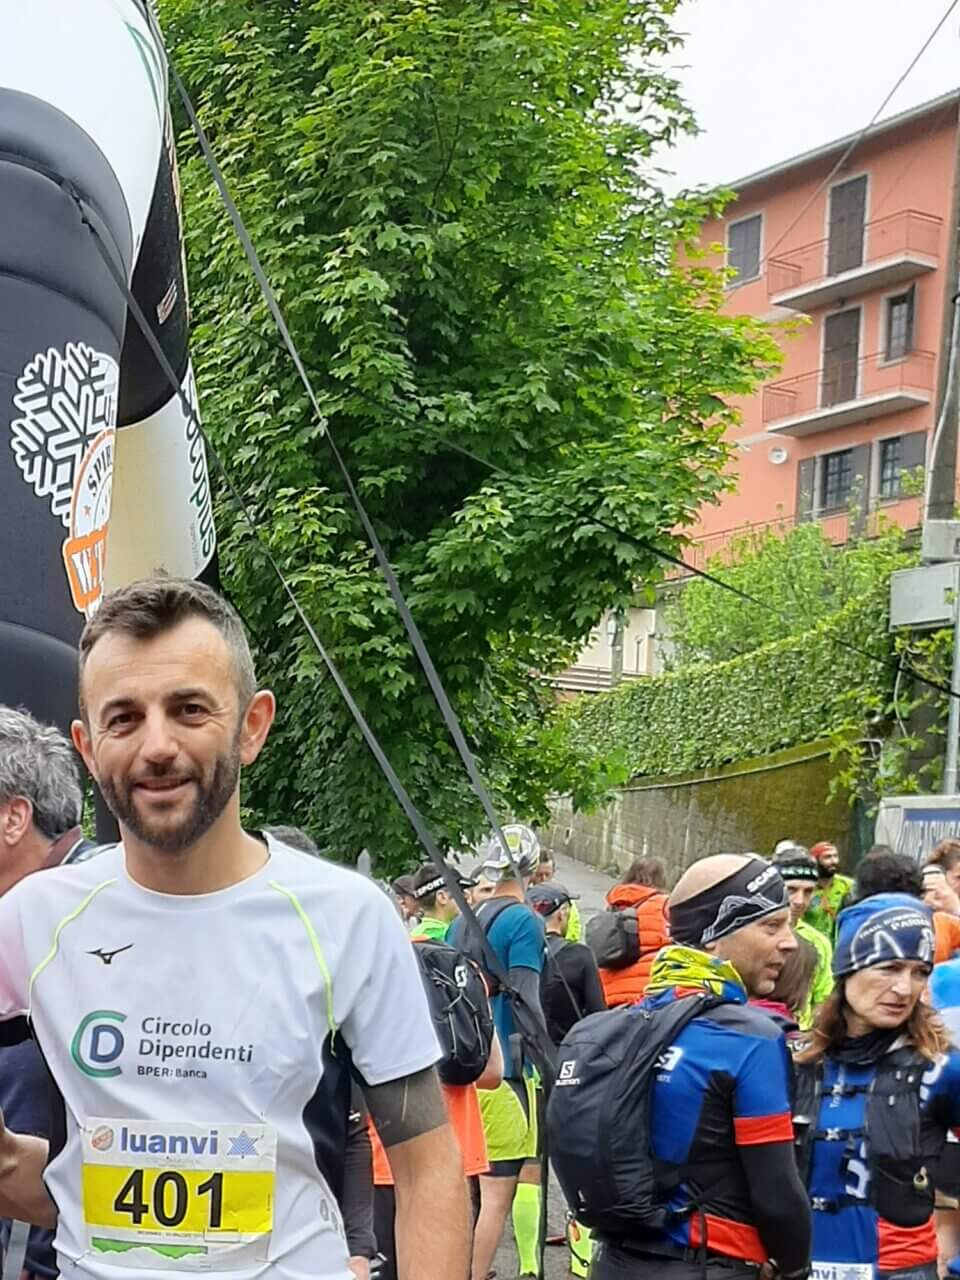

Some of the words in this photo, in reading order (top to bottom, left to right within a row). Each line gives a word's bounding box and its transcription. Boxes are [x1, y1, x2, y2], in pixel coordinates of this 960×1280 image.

[141, 1016, 212, 1036] Circolo
[138, 1039, 254, 1063] Dipendenti
[120, 1127, 219, 1155] luanvi
[114, 1169, 224, 1228] 401
